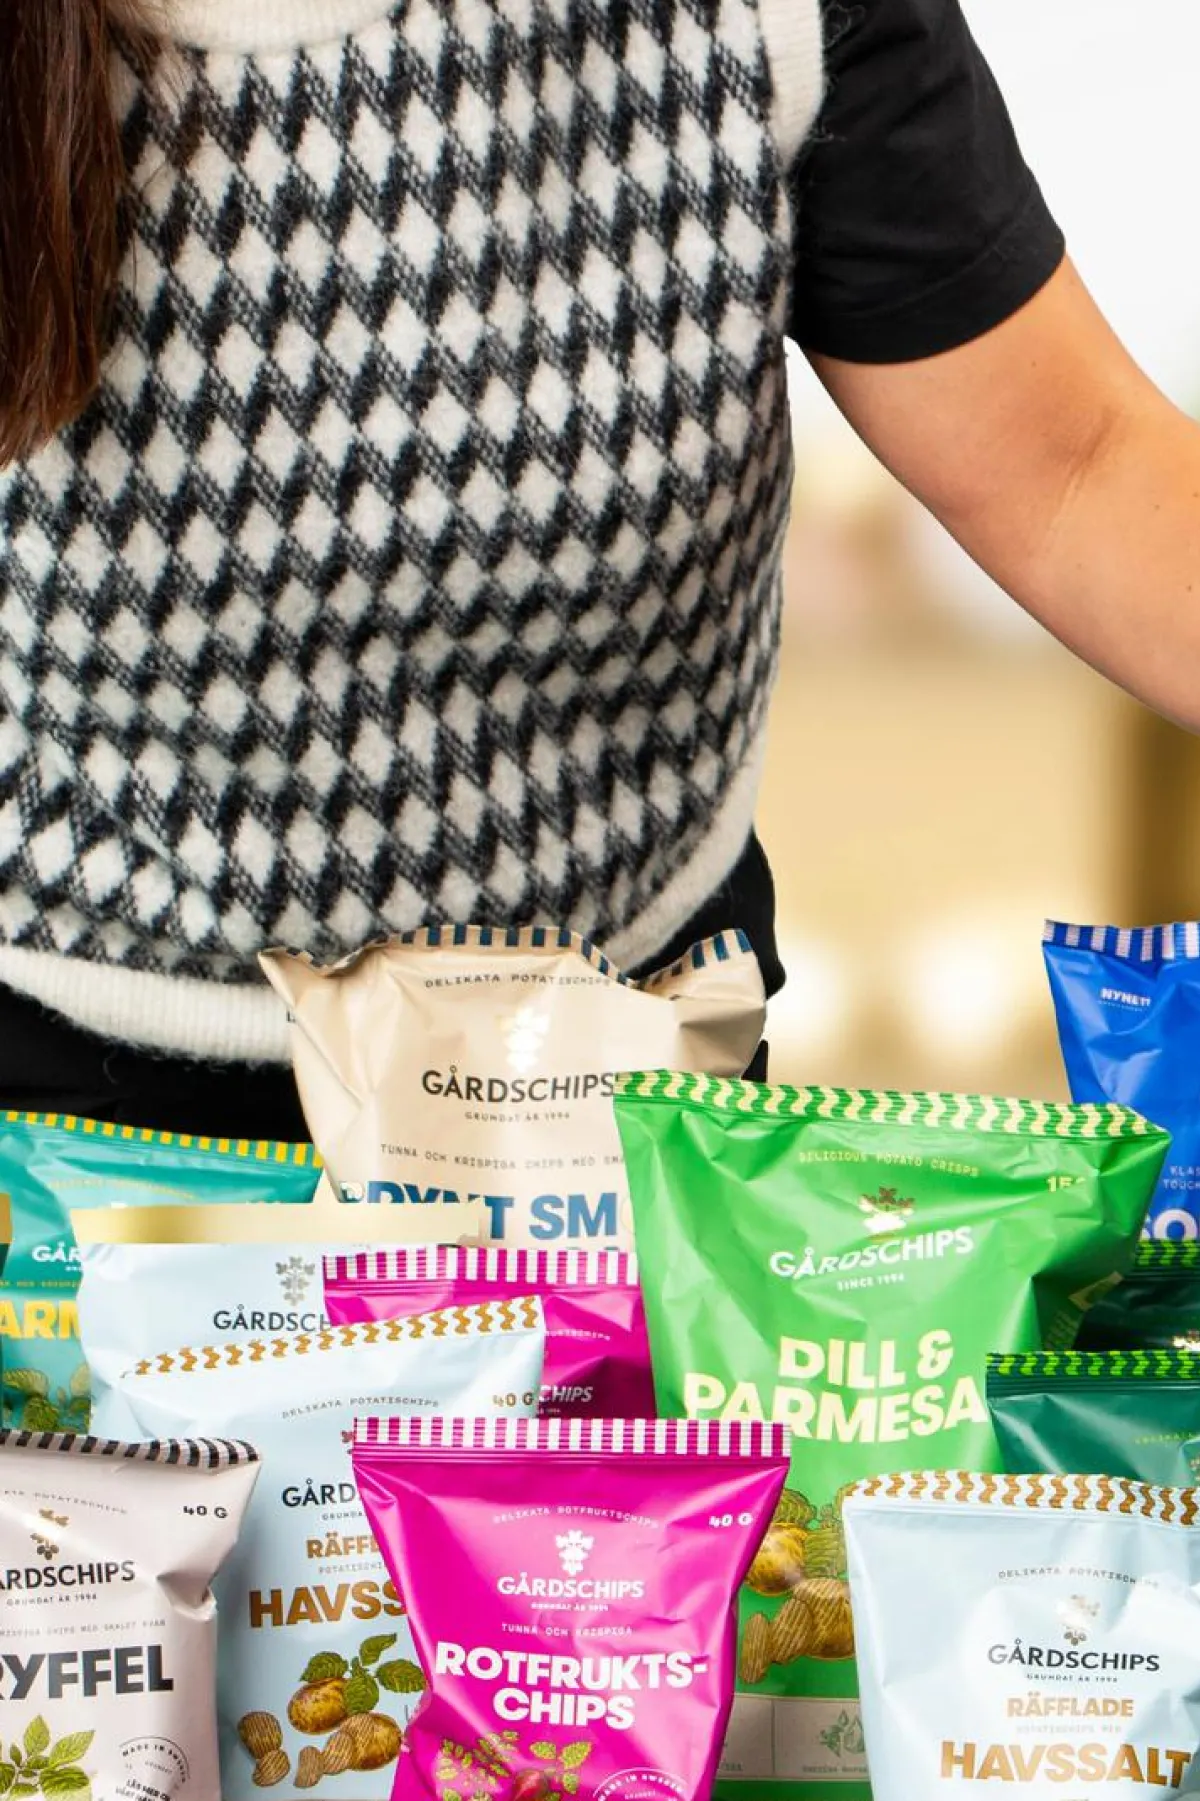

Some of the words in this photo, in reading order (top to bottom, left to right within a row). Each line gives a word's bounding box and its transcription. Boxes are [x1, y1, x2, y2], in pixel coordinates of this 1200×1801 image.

[425, 974, 500, 988] DELIKATA
[422, 1065, 614, 1103] GÅRDSCHIPS
[380, 1143, 418, 1158] TUNNA
[425, 1150, 447, 1163] OCH
[876, 1152, 922, 1167] POTATO
[930, 1158, 981, 1177] CRISPS
[529, 1192, 618, 1240] SM
[770, 1225, 975, 1280] GÅRDSCHIPS
[837, 1277, 874, 1291] SINCE
[878, 1273, 905, 1286] 1994
[778, 1335, 907, 1391] DILL
[916, 1328, 954, 1379] &
[493, 1393, 515, 1407] 40
[523, 1392, 534, 1406] G
[539, 1385, 594, 1402] CHIPS
[683, 1373, 989, 1443] PARMESA
[183, 1505, 207, 1516] 40
[214, 1507, 228, 1519] G
[322, 1510, 366, 1520] GRUNDA
[709, 1514, 733, 1528] 40
[738, 1512, 753, 1526] G
[0, 1560, 136, 1591] RDSCHIPS
[319, 1562, 383, 1575] POTATISCHI
[999, 1566, 1061, 1578] DELIKATA
[497, 1572, 644, 1600] GÅRDSCHIPS
[249, 1580, 407, 1628] HAVSS
[501, 1622, 538, 1635] TUNNA
[545, 1626, 568, 1637] OCH
[435, 1642, 708, 1691] ROTFRUKTS-
[988, 1638, 1160, 1672] GÅRDSCHIPS
[0, 1644, 174, 1701] YFFEL
[492, 1687, 635, 1730] CHIPS
[1007, 1690, 1134, 1718] RÄFFLADE
[940, 1740, 1192, 1789] HAVSSALT
